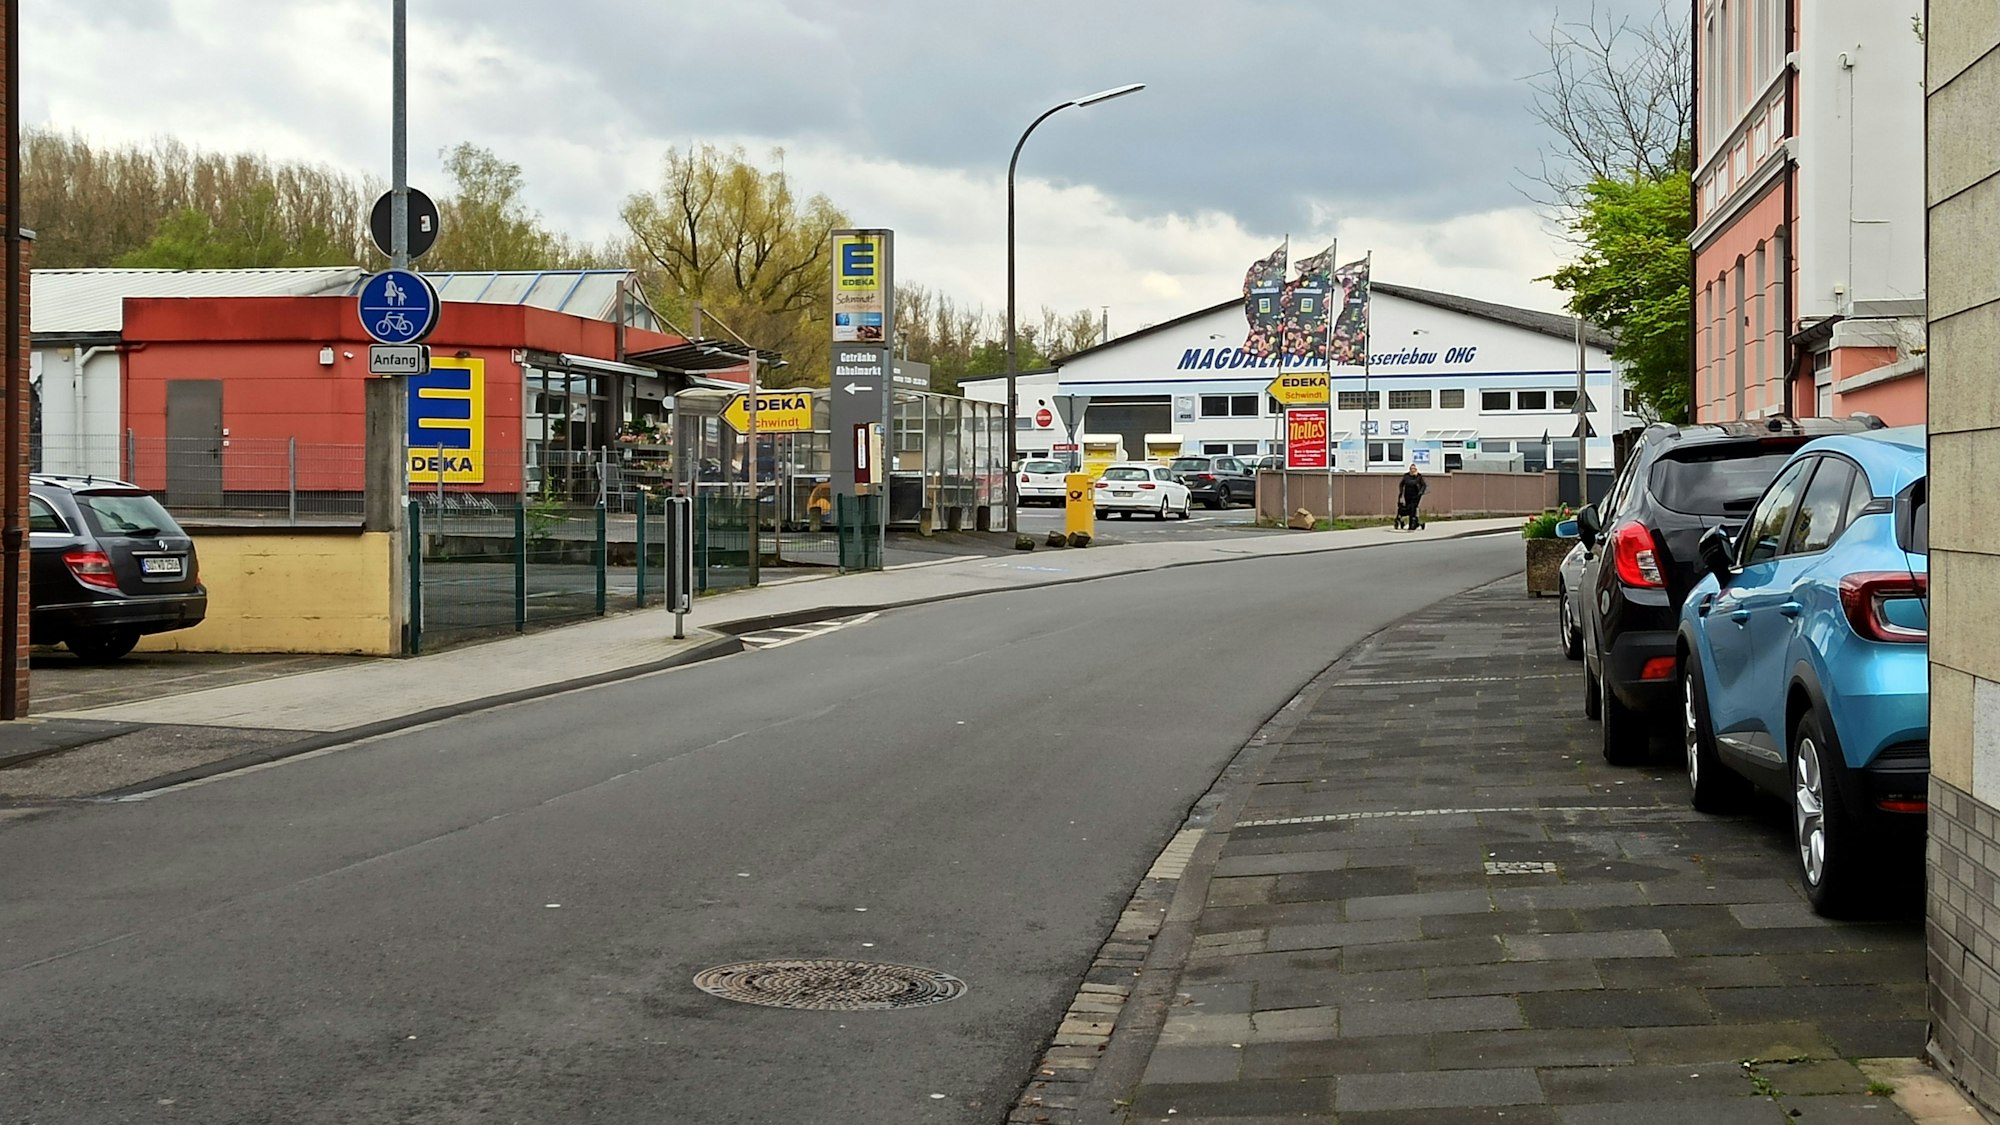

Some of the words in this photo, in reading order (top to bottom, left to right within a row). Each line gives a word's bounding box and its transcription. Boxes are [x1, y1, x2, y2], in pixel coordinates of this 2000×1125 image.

[840, 353, 877, 362] Getränke
[1444, 346, 1477, 364] OHG
[373, 354, 416, 368] Anfang
[836, 366, 881, 376] Abholmarkt
[1282, 378, 1327, 387] EDEKA
[1285, 391, 1322, 399] Schwindt
[411, 457, 473, 472] DEKA
